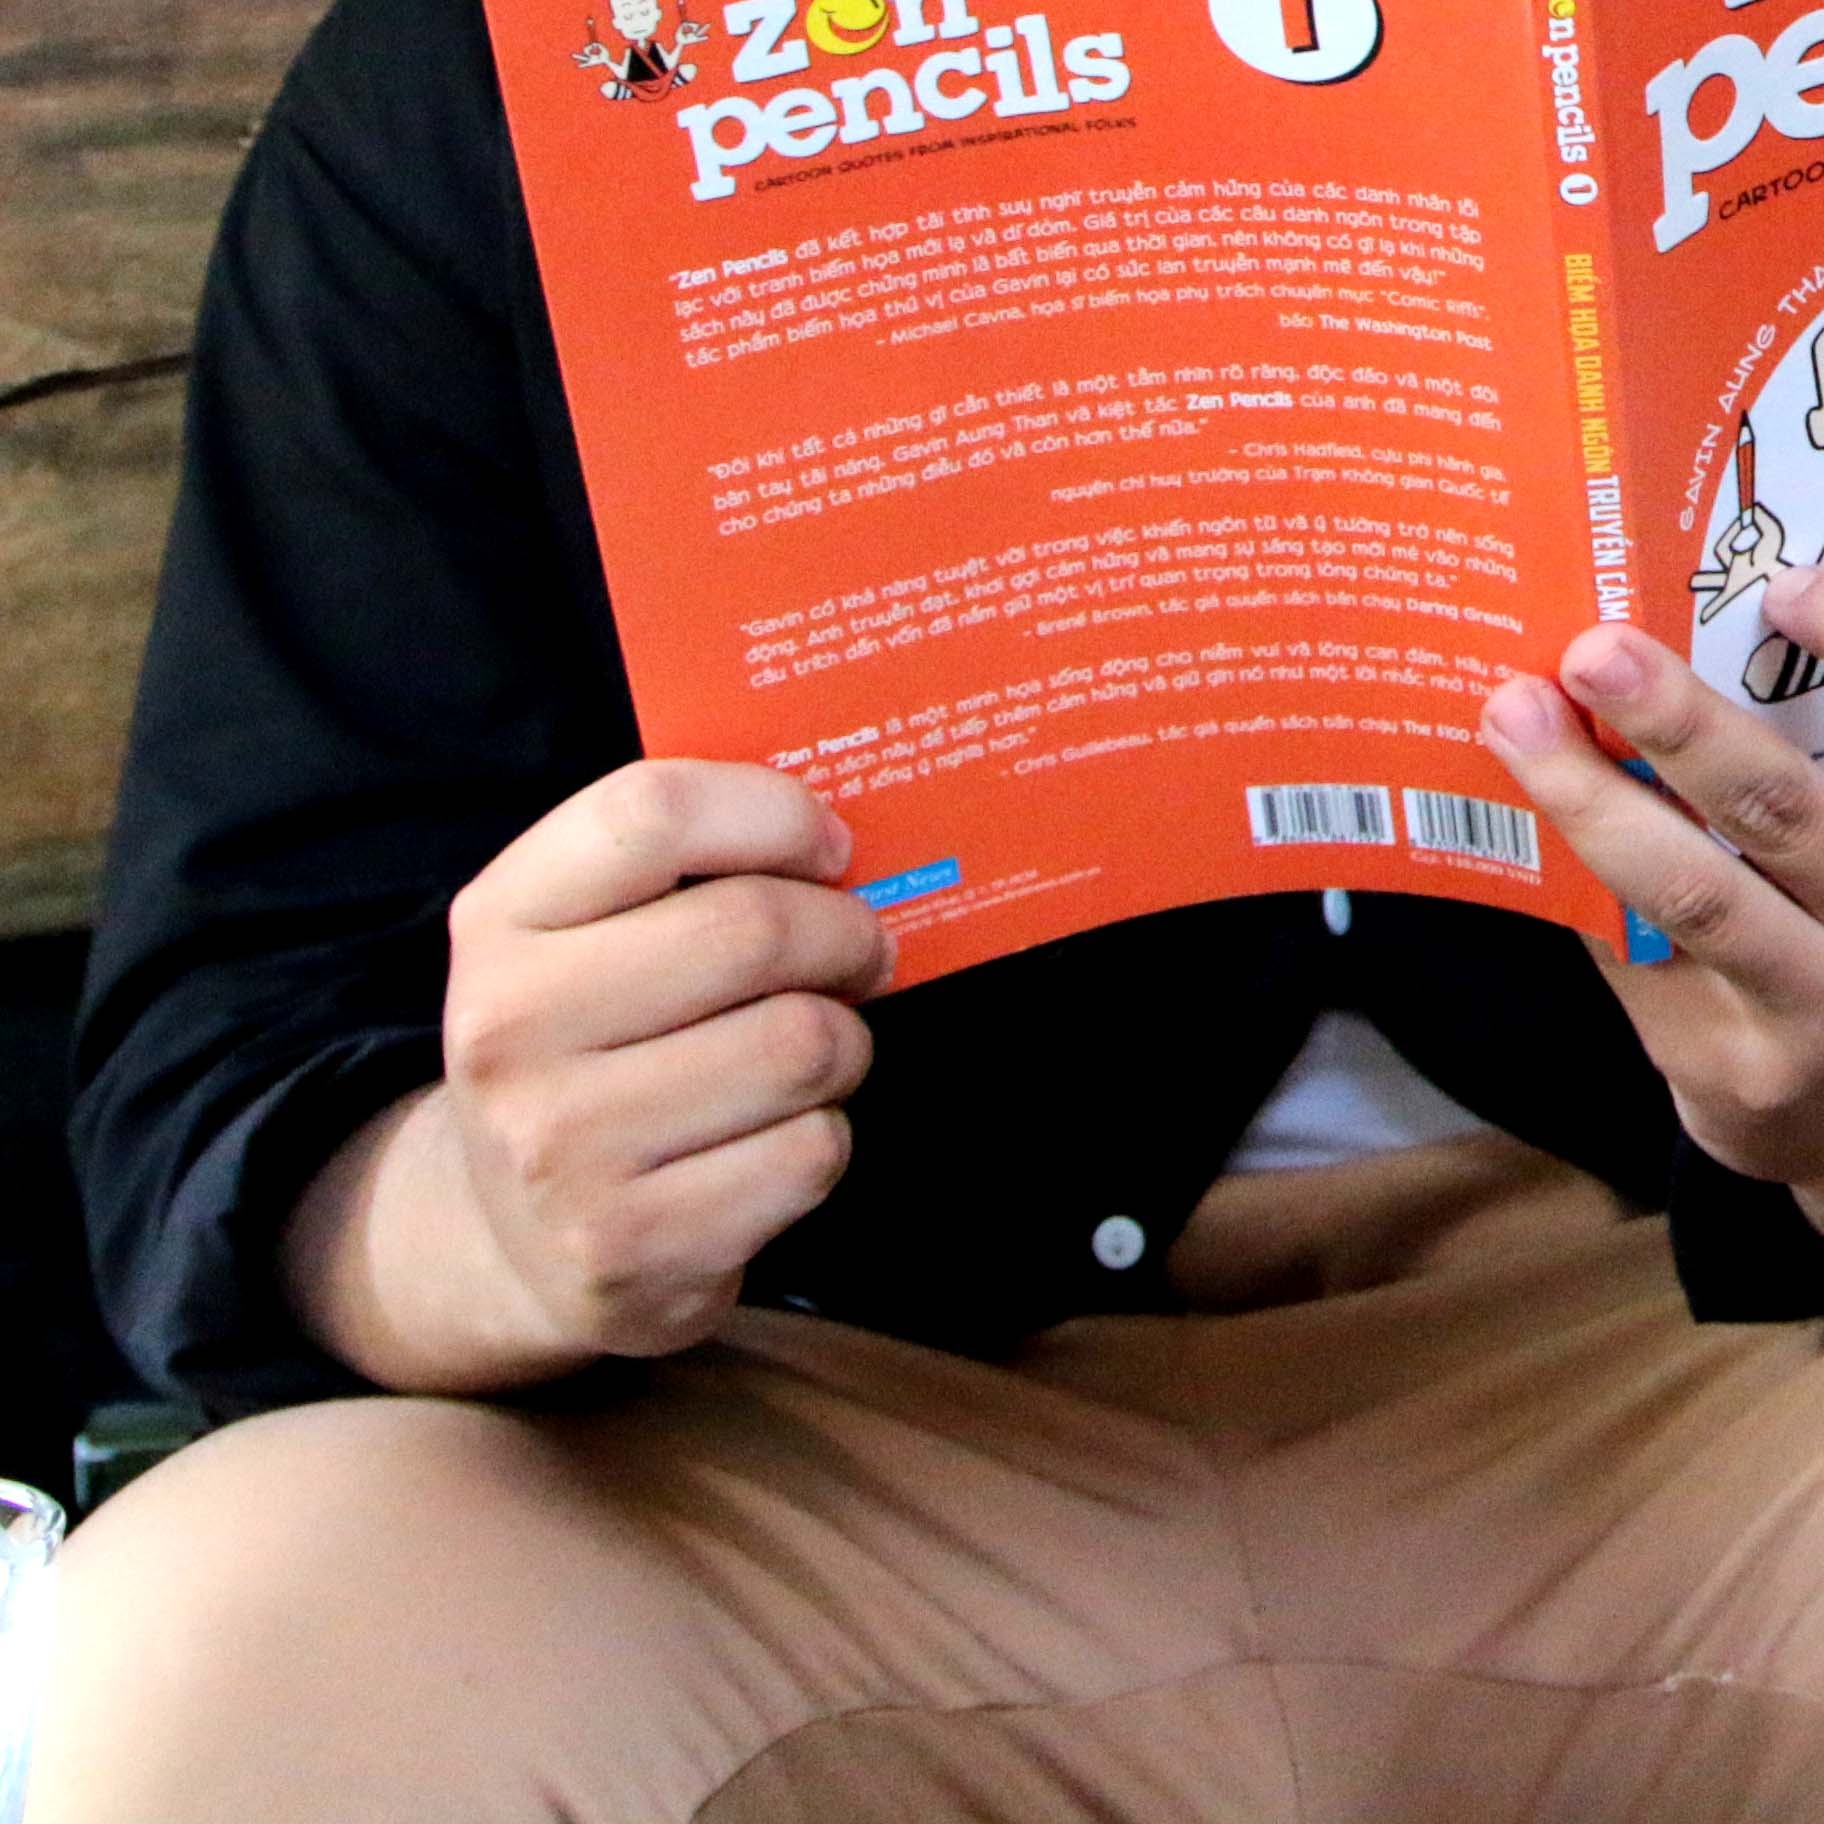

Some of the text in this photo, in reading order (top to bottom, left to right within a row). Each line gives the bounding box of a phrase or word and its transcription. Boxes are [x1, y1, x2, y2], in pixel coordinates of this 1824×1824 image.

[677, 14, 1131, 201] pencils
[1542, 43, 1596, 163] pencils
[754, 117, 1137, 191] CARTOON QUOTES FROM INSPIRATIONAL FOLKS
[1575, 355, 1606, 412] DANH
[1680, 424, 1723, 532] GAVIN
[1718, 324, 1776, 414] AUNG
[1580, 418, 1614, 472] NGÔN
